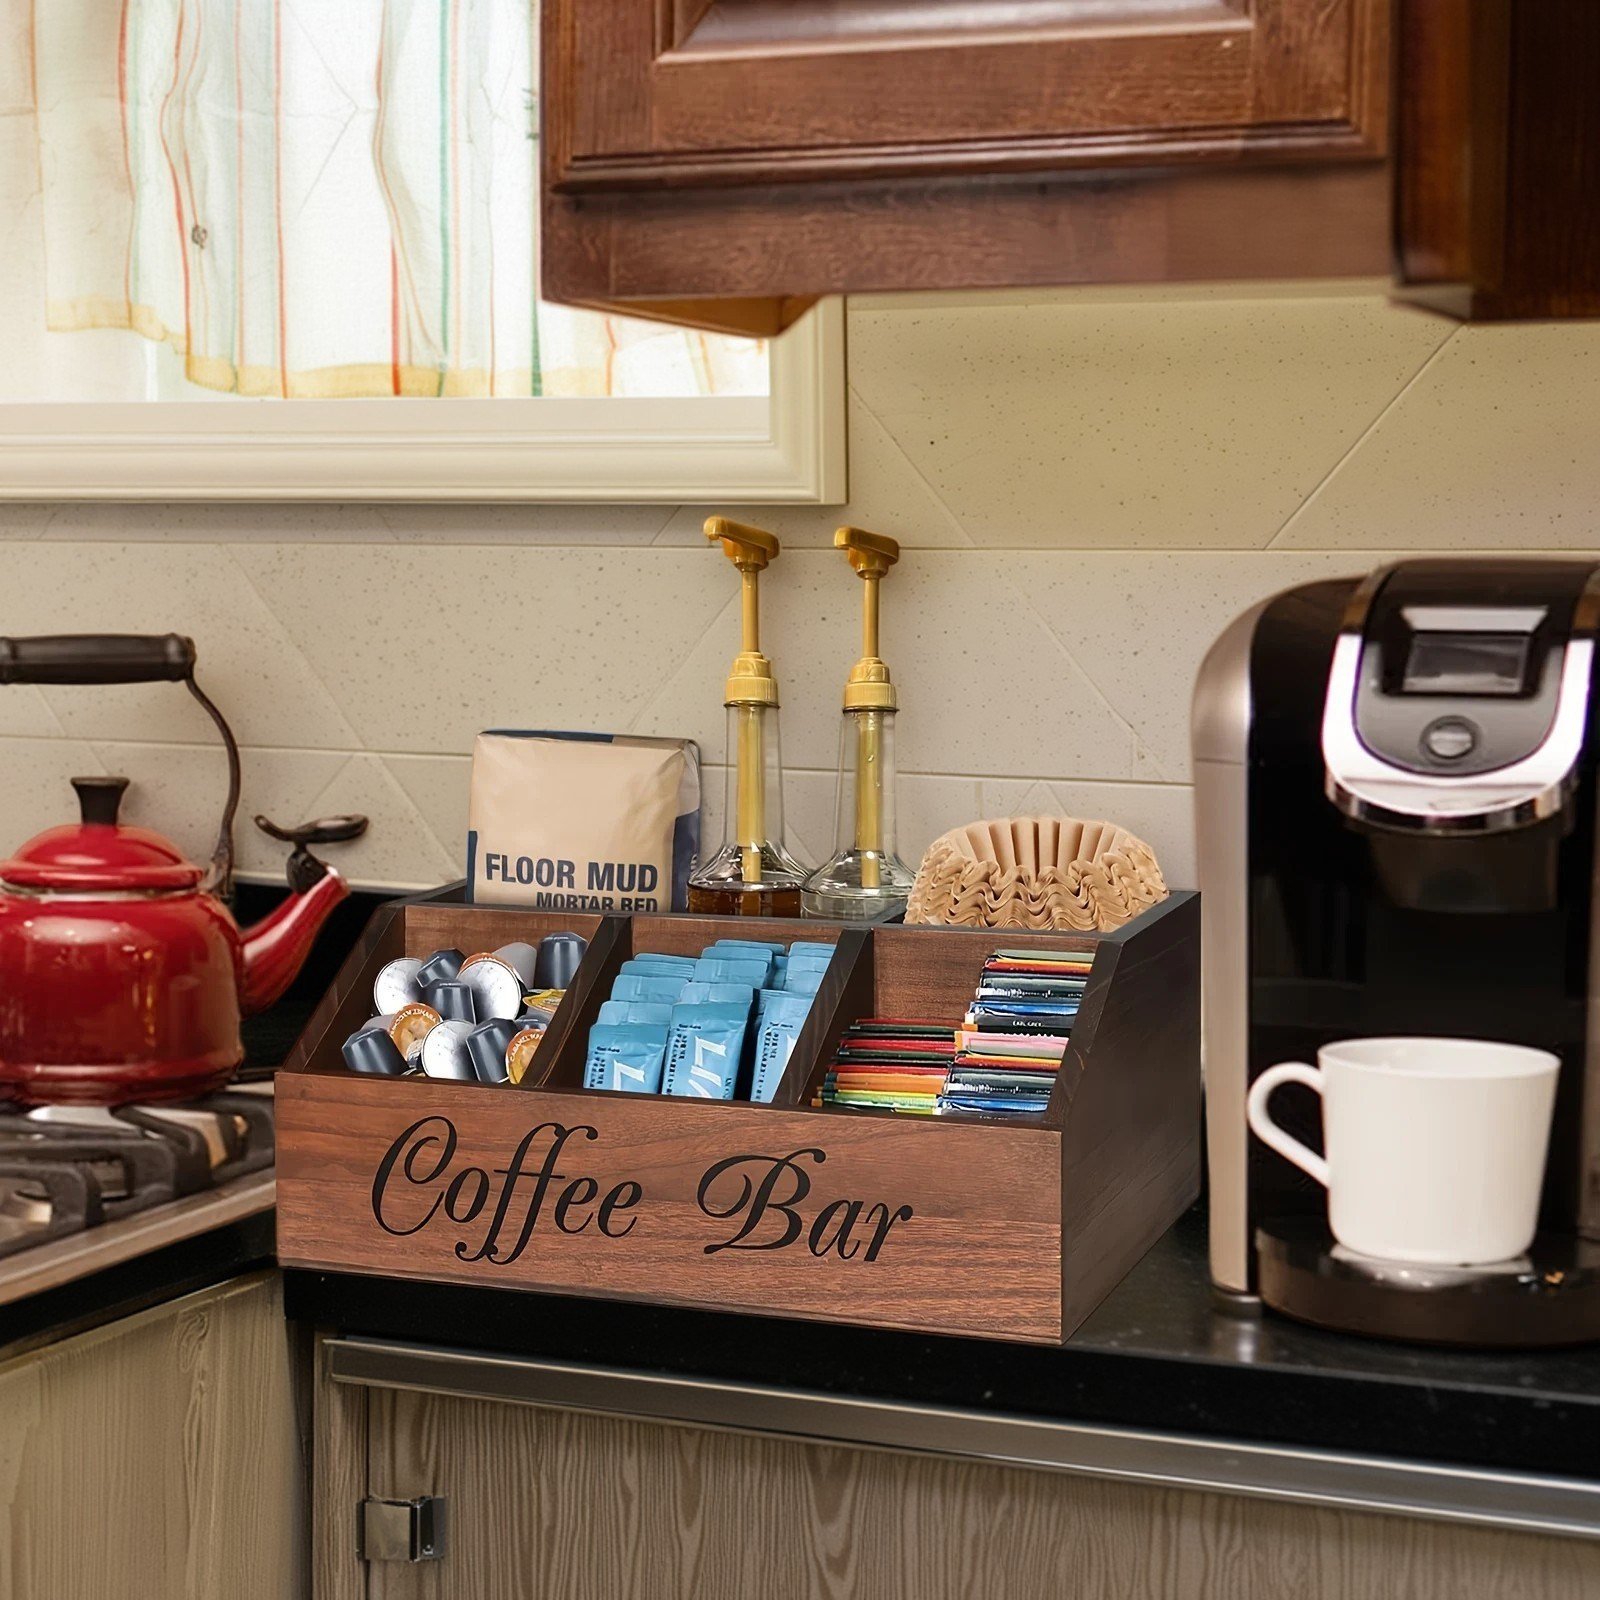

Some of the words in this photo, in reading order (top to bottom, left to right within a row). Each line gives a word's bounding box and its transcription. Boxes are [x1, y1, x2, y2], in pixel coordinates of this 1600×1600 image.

[485, 853, 576, 890] FLOOR
[587, 861, 659, 894] MUD
[536, 891, 614, 911] MORTAR
[620, 897, 659, 913] BED
[371, 1115, 643, 1265] Coffee
[696, 1148, 913, 1262] Bar
